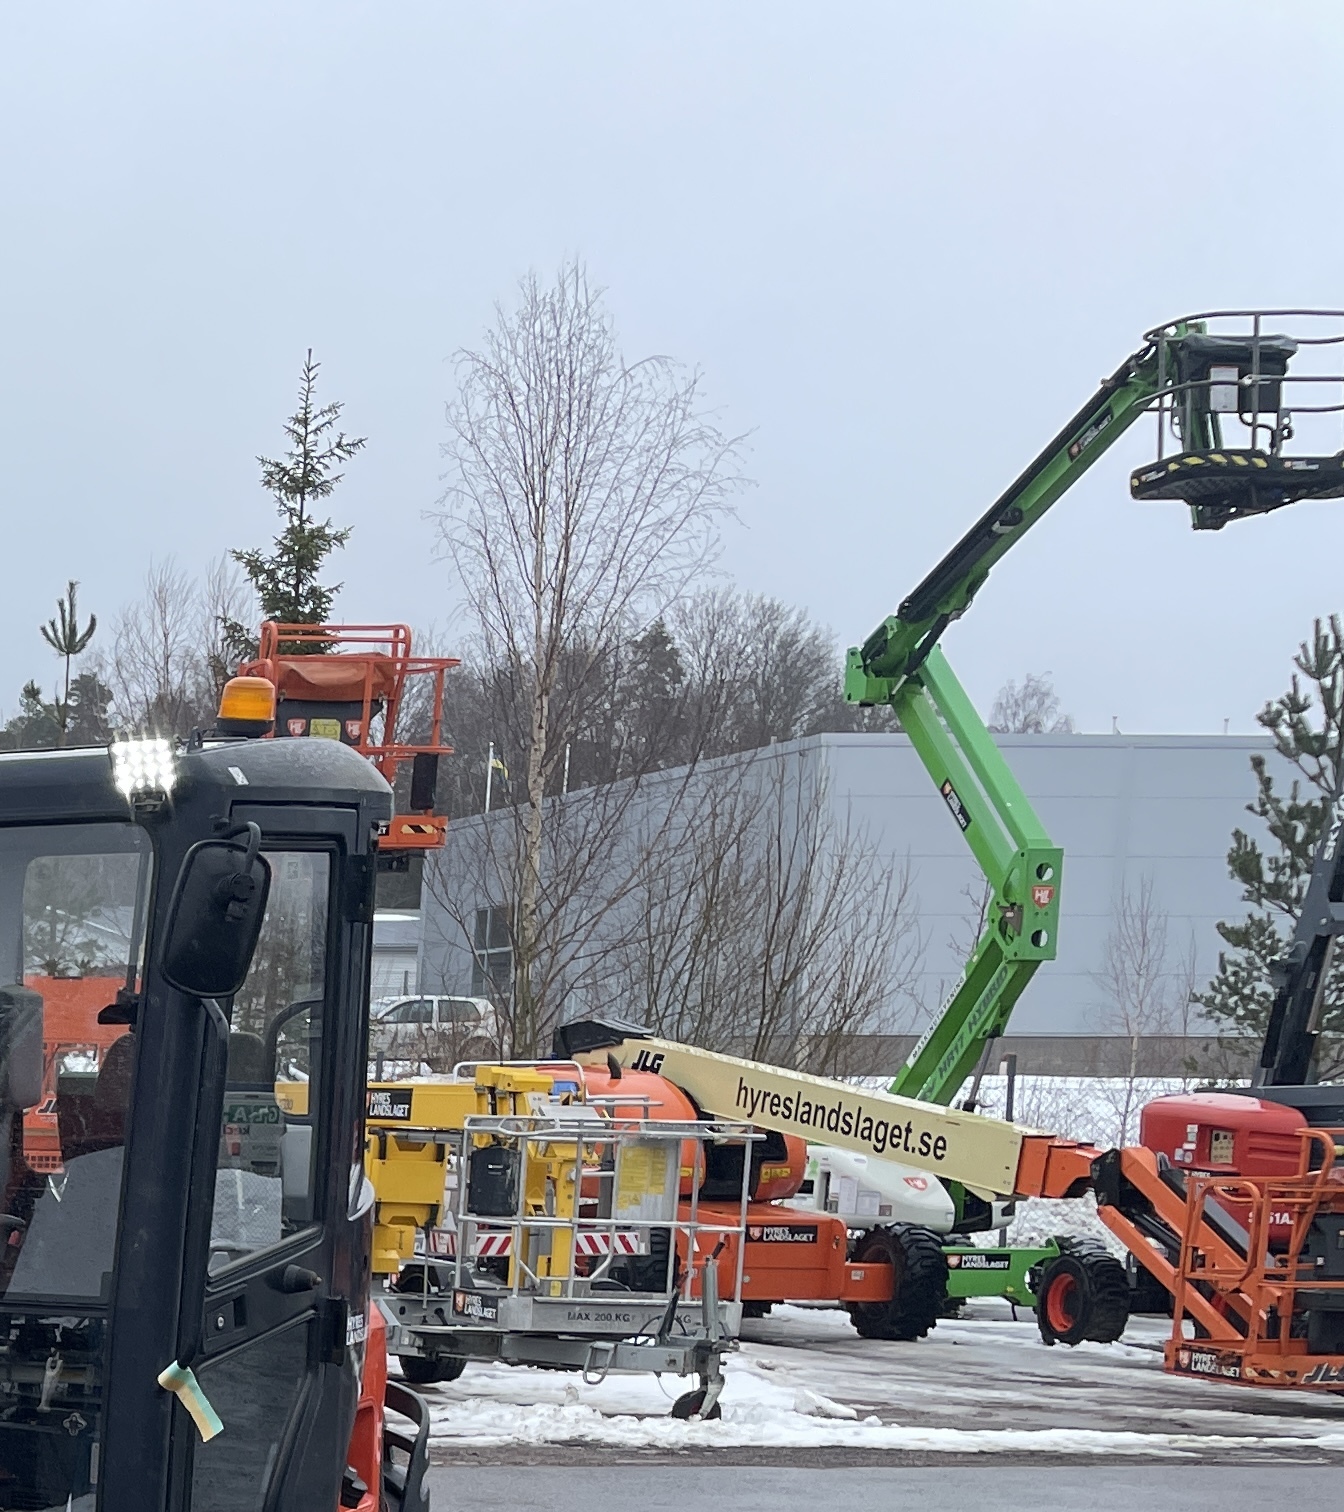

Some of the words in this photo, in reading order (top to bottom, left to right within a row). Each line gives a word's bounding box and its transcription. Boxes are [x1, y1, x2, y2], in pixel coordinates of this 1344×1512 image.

[631, 1049, 665, 1075] JLG
[736, 1077, 947, 1161] hyreslandslaget.se
[567, 1311, 591, 1321] MAX
[593, 1312, 613, 1322] 200
[615, 1313, 632, 1323] KG
